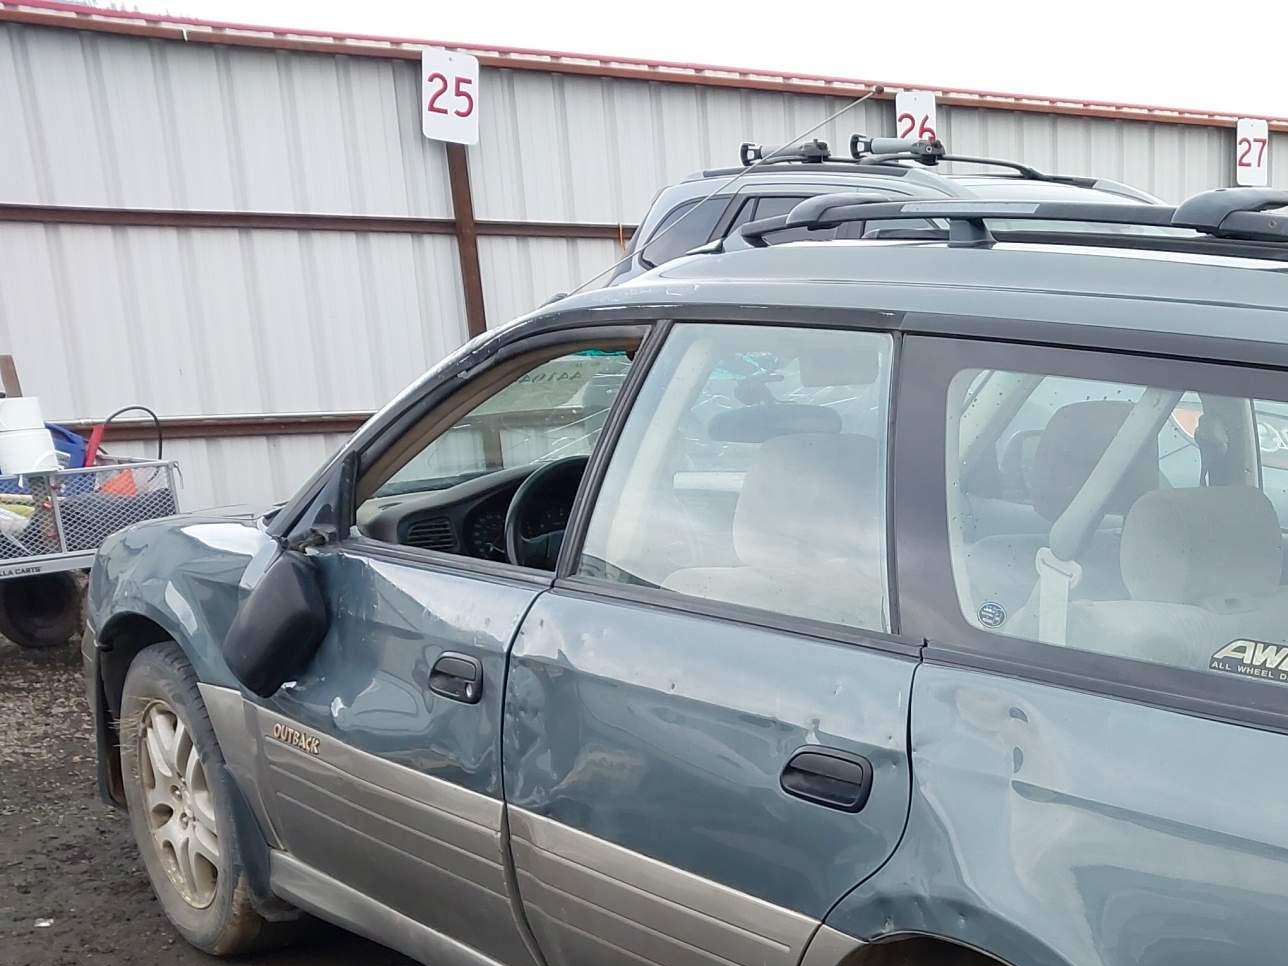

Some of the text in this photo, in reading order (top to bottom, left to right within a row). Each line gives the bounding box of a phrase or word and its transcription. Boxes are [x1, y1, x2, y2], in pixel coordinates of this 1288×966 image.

[427, 72, 474, 118] 25
[898, 112, 936, 140] 26
[1238, 137, 1267, 168] 27
[1211, 661, 1232, 671] ALL
[1237, 665, 1274, 679] WHEEL
[272, 722, 321, 754] OUTBACK
